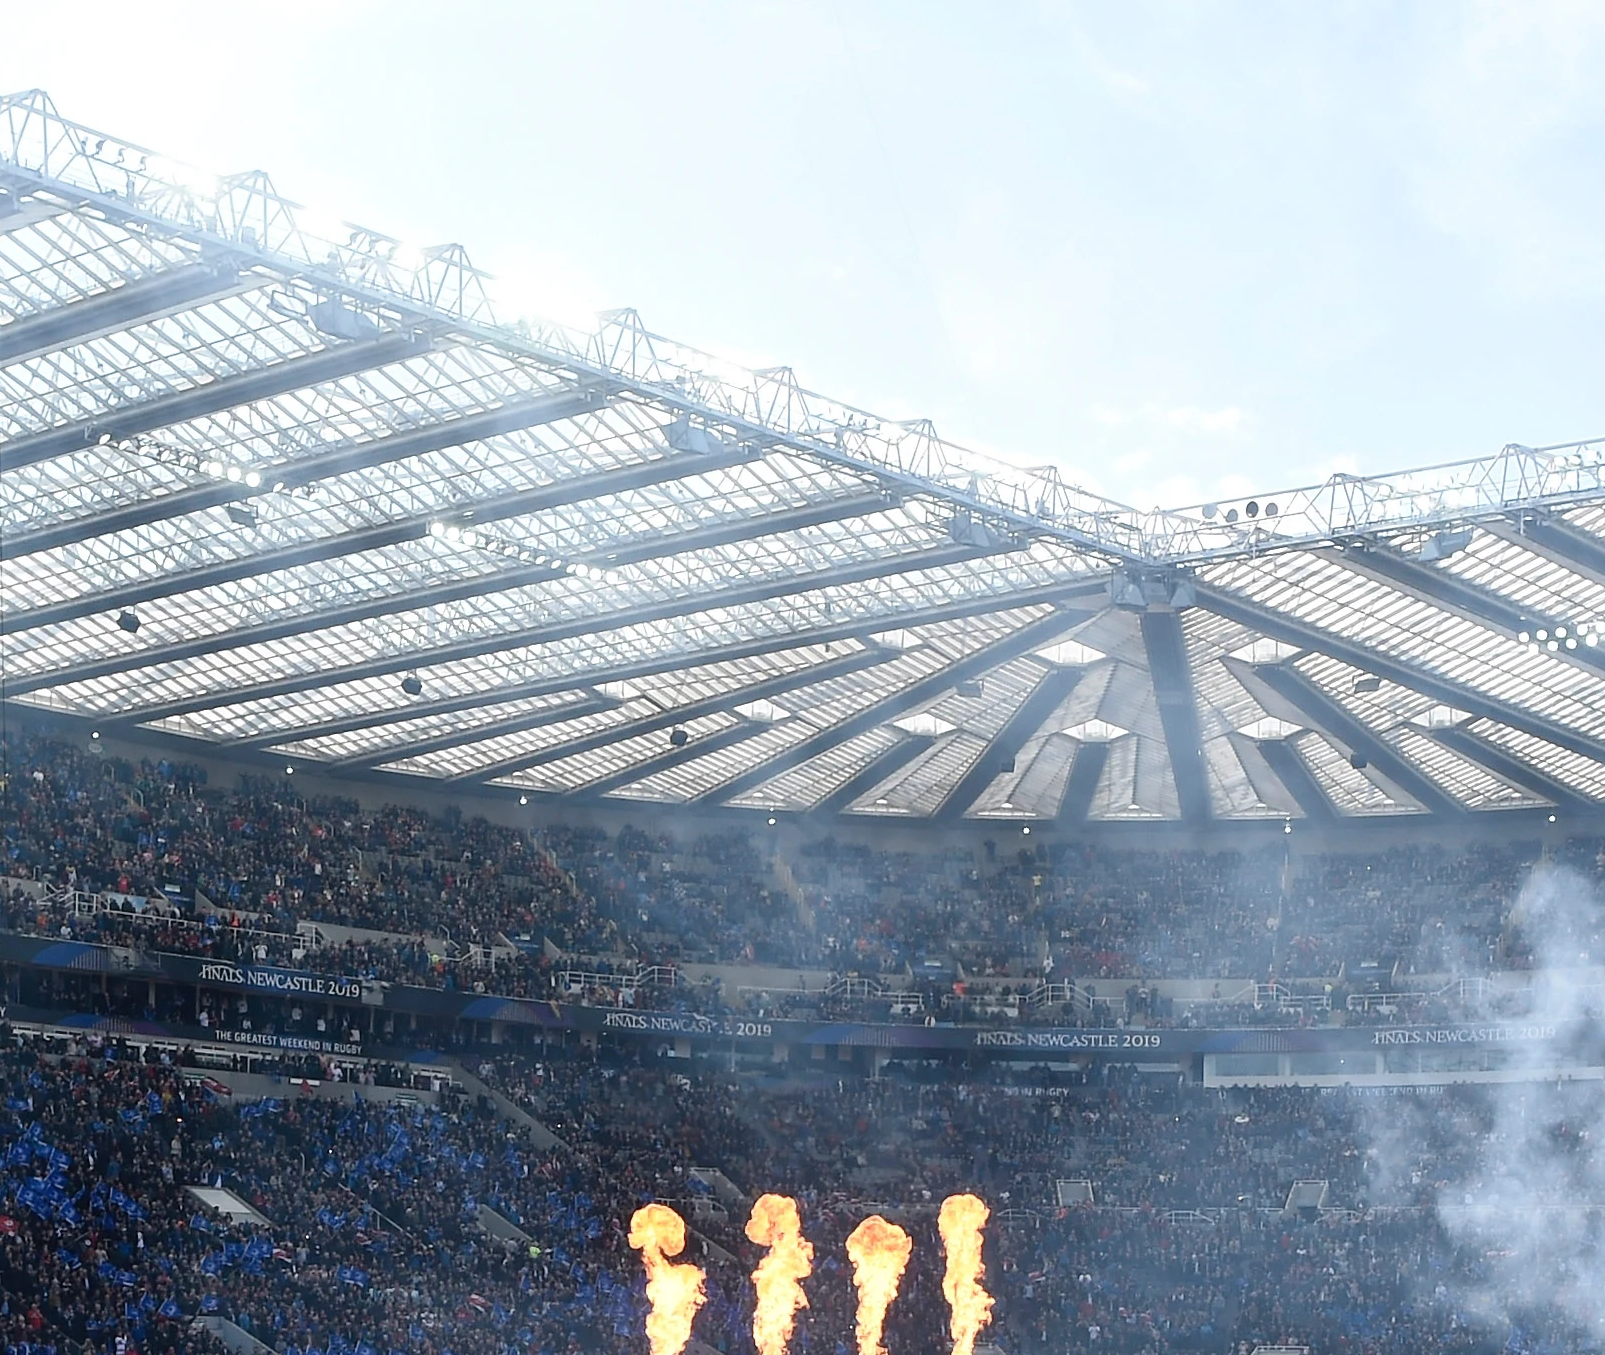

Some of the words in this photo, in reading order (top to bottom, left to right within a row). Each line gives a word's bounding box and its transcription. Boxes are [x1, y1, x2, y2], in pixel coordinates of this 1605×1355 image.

[199, 964, 246, 983] FINALS
[247, 970, 325, 994] NEWCASTLE
[603, 1012, 647, 1029] FINALS
[736, 1022, 772, 1036] 2019
[1426, 1027, 1514, 1043] NEWCASTLE
[1519, 1025, 1556, 1040] 2019
[215, 1029, 232, 1041] THE
[234, 1032, 277, 1047] GREATEST
[280, 1037, 320, 1051] WEEKEND
[322, 1042, 332, 1052] IN
[333, 1042, 363, 1055] RUGBY
[1027, 1034, 1118, 1047] NEWCASTLE
[1122, 1034, 1161, 1047] 2019
